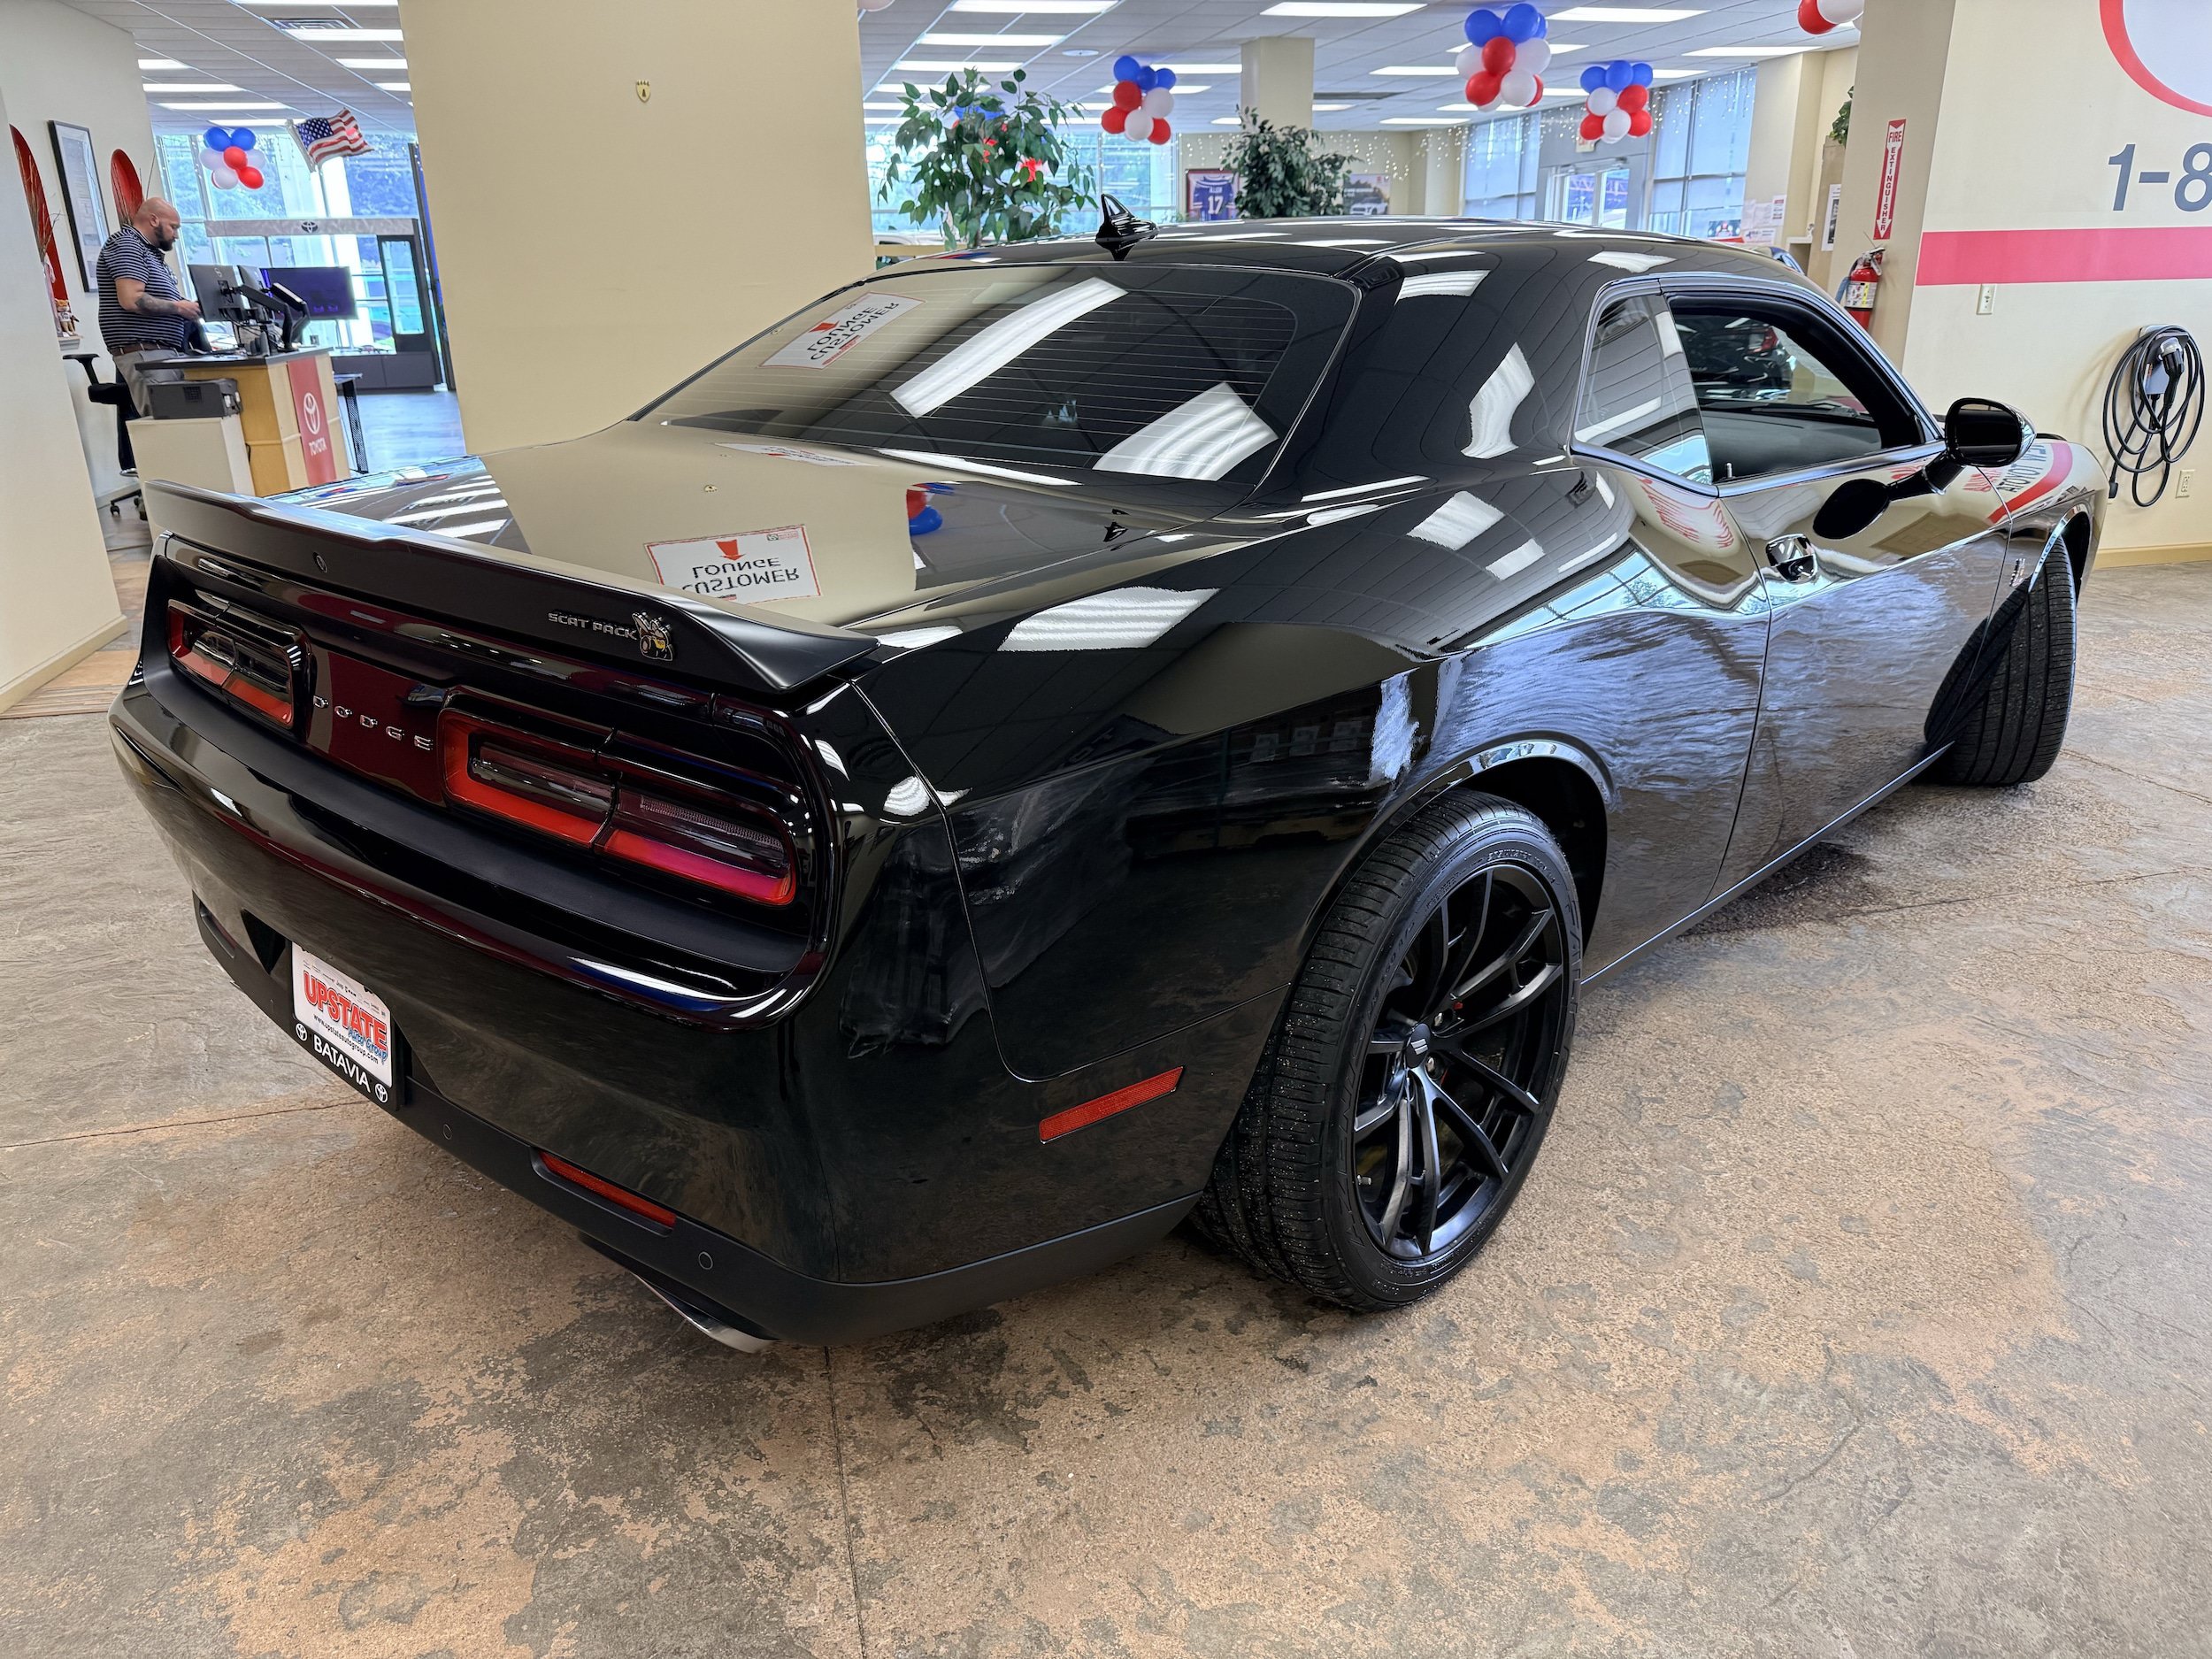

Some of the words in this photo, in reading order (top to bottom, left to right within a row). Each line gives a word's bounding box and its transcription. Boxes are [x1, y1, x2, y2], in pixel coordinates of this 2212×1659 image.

[1887, 130, 1902, 142] FIRE
[1207, 195, 1224, 215] 17
[1880, 146, 1896, 231] EXTINGUISHER
[548, 611, 589, 629] SCAT
[592, 620, 638, 641] PACK
[312, 695, 434, 751] DODGE
[303, 970, 388, 1051] UPSTATE
[313, 1013, 380, 1064] www.upstateautogroup.com
[313, 1033, 372, 1094] BATAVIA
[348, 1027, 365, 1047] Auto
[366, 1038, 388, 1065] Group
